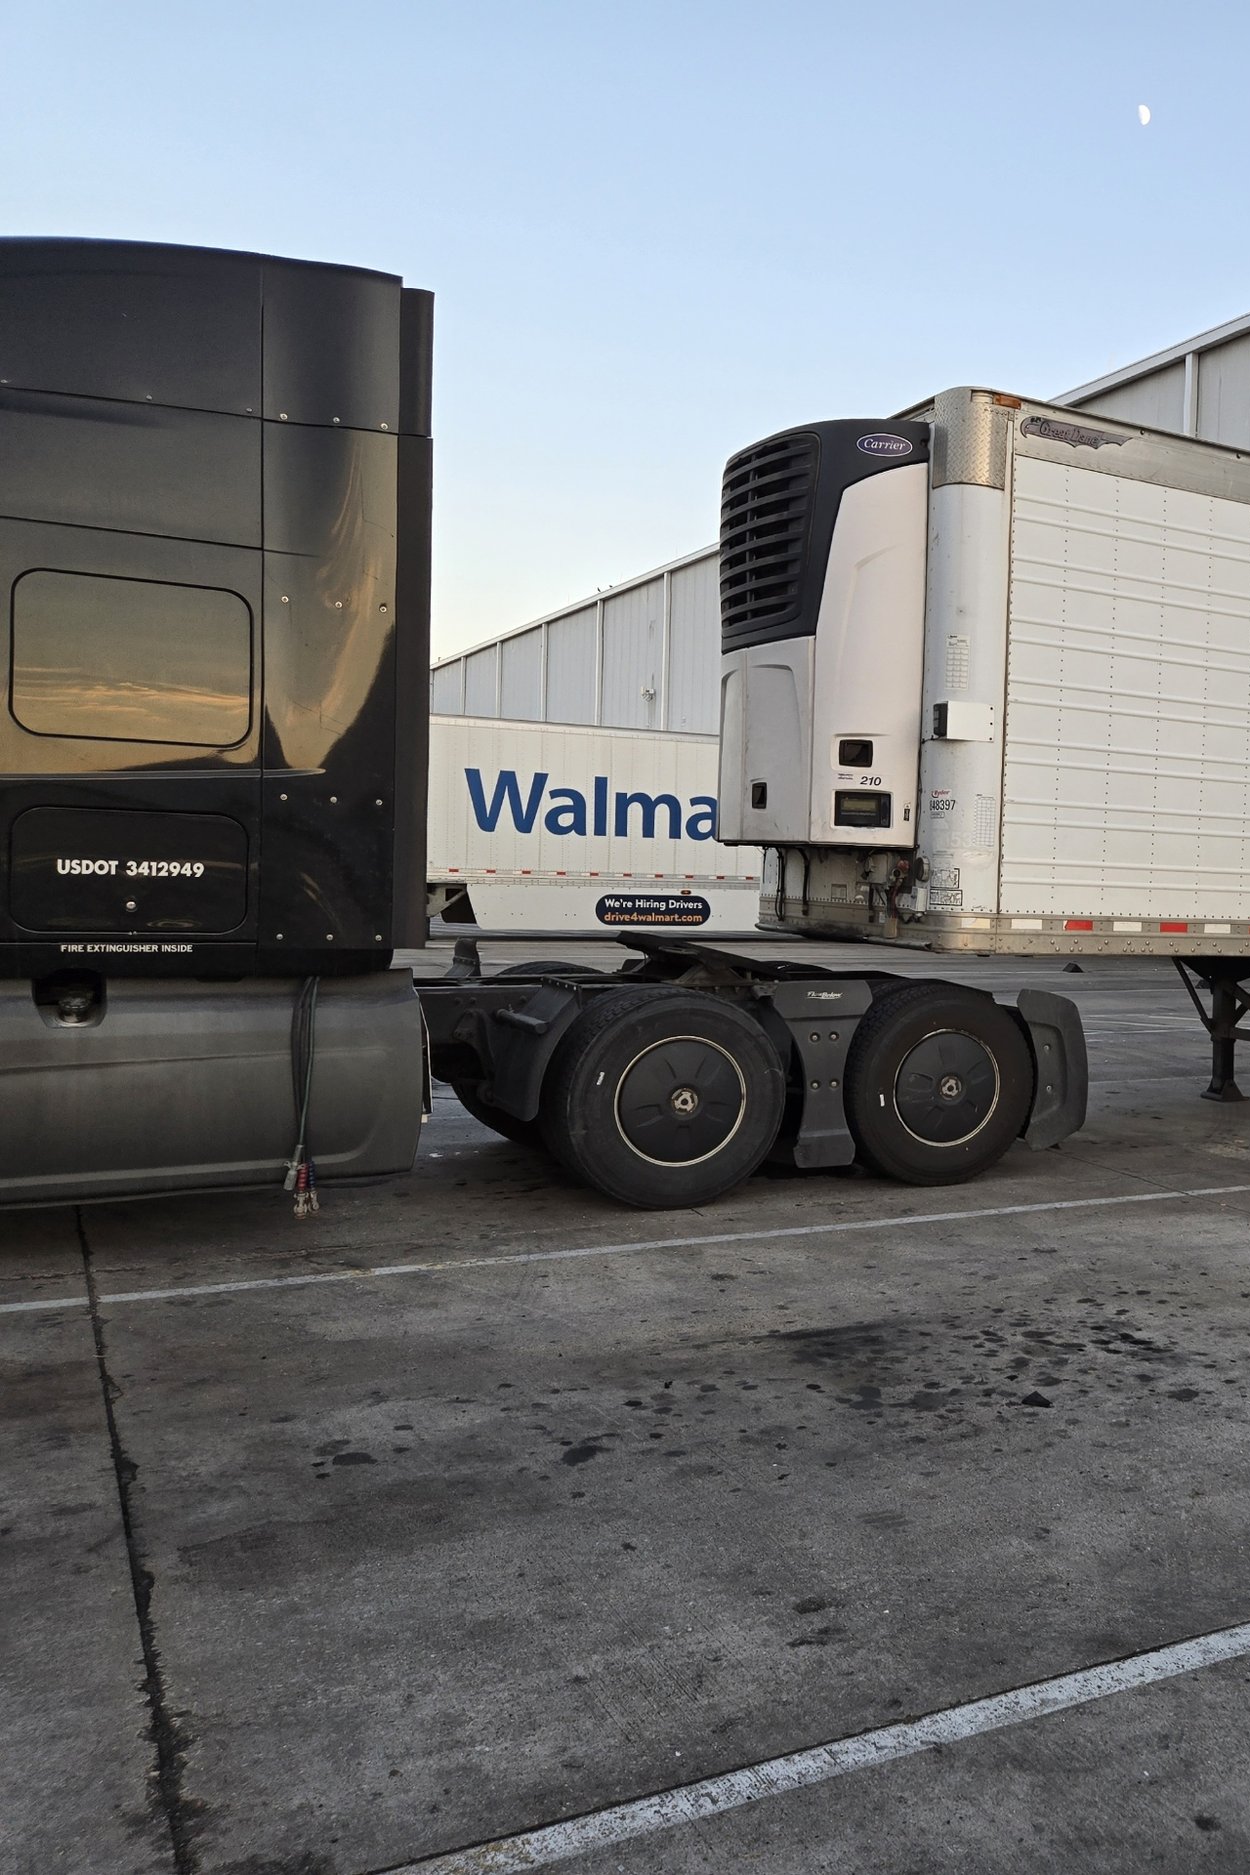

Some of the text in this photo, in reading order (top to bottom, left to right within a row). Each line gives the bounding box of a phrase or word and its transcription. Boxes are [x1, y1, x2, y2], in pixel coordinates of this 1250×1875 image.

[864, 438, 906, 450] Carrier
[860, 776, 882, 786] 210
[57, 859, 205, 877] USDOT 3412949
[604, 898, 703, 911] We're Hiring Drivers
[604, 912, 703, 923] drive4walmart.com
[60, 944, 193, 953] FIRE EXTINGUISHER INSIDE
